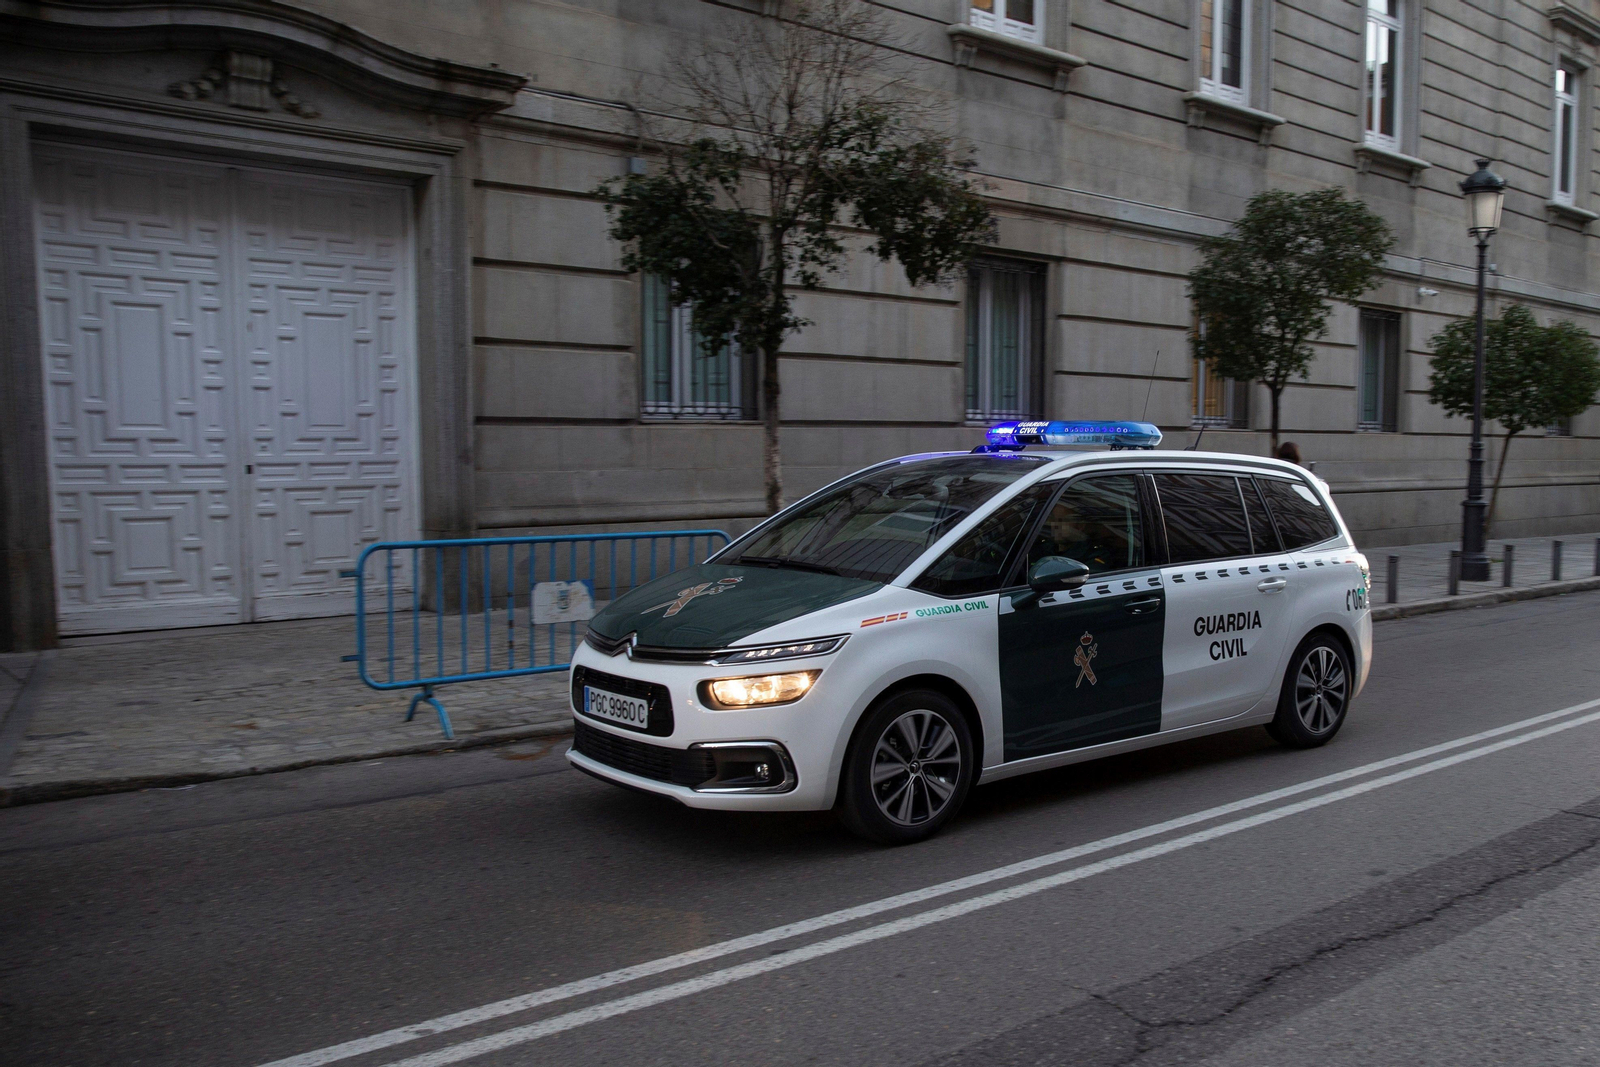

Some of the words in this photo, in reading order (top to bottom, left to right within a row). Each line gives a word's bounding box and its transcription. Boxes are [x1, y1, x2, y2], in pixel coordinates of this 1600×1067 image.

[915, 604, 962, 617] GUARDIA
[964, 600, 989, 611] CIVIL
[1194, 610, 1262, 636] GUARDIA
[1209, 638, 1247, 661] CIVIL
[590, 691, 608, 714] PGC
[609, 697, 636, 721] 9960
[637, 703, 645, 723] C
